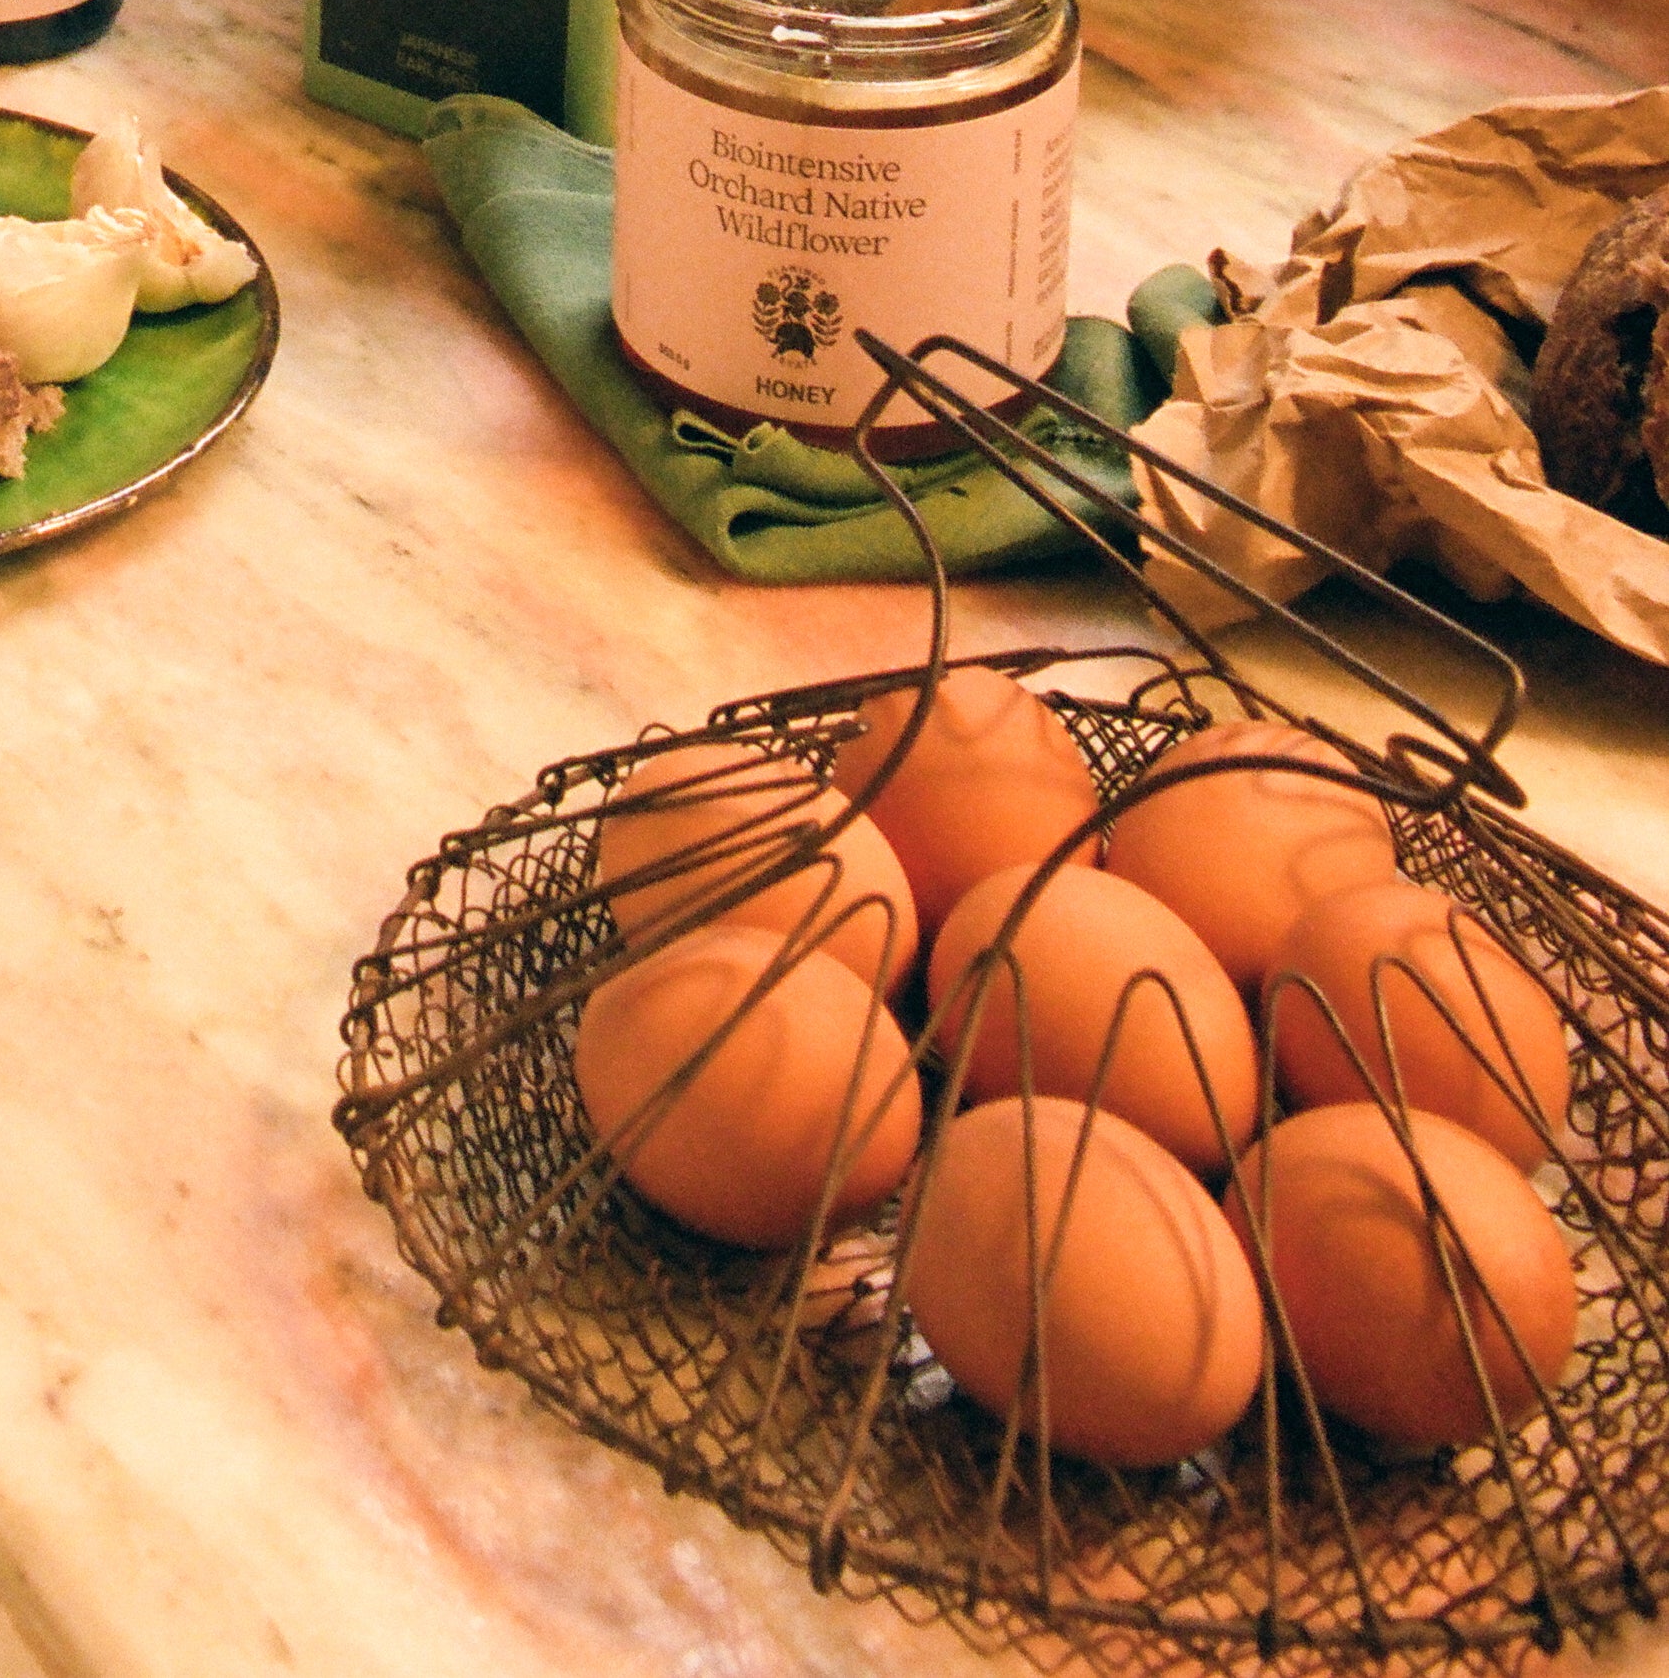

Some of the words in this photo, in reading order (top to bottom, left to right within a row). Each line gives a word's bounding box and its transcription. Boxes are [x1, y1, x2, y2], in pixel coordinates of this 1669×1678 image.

[711, 128, 901, 184] Biointensive
[689, 158, 813, 216] Orchard
[824, 190, 927, 219] Native
[715, 205, 890, 257] Wildflower
[755, 375, 836, 406] HONEY
